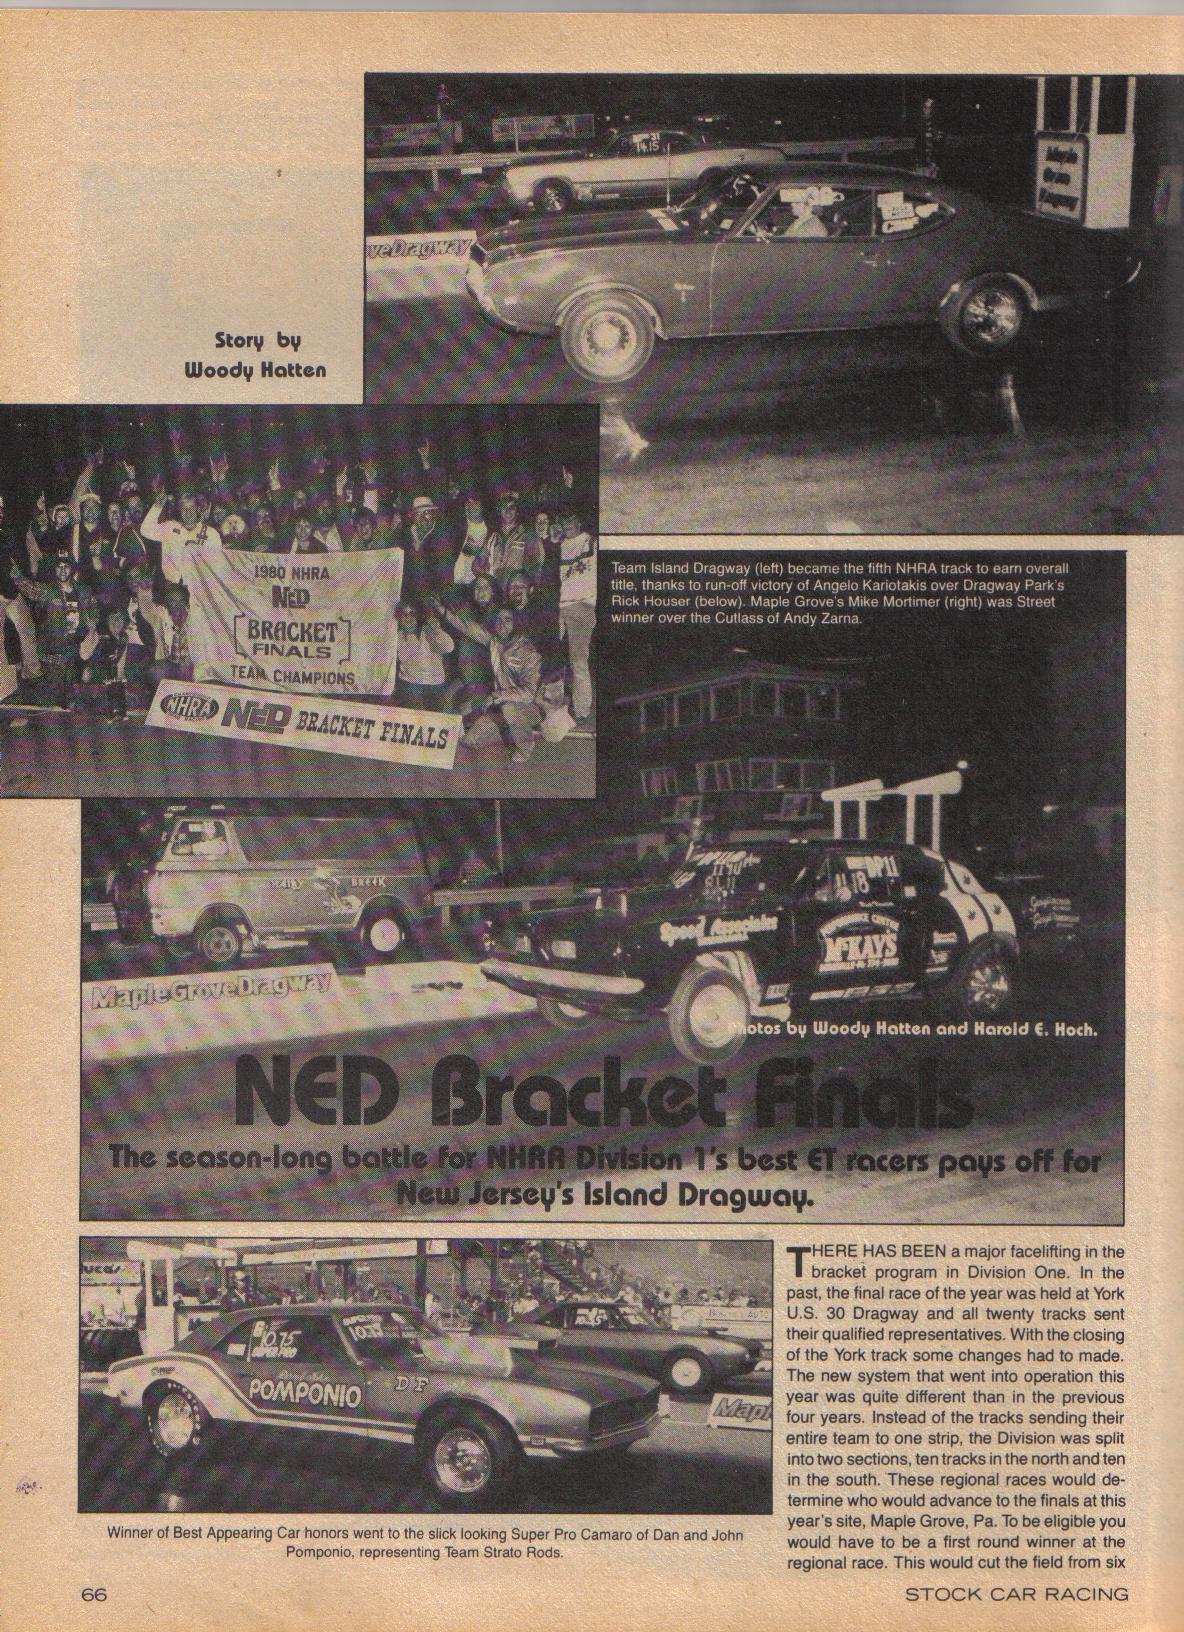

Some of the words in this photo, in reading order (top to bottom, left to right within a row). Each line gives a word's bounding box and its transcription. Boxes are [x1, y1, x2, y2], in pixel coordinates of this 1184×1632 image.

[216, 332, 263, 352] Story
[278, 332, 301, 352] by
[185, 362, 253, 382] Woody
[262, 362, 326, 377] Hatten
[253, 564, 285, 579] 1980
[292, 566, 330, 580] NHRA
[612, 562, 646, 573] Team
[652, 563, 688, 573] Island
[694, 562, 750, 576] Dragway
[756, 563, 783, 576] (left)
[789, 563, 839, 574] became
[844, 563, 863, 573] the
[869, 563, 891, 573] fifth
[897, 563, 936, 573] NHRA
[942, 564, 971, 573] track
[977, 564, 988, 574] to
[1026, 563, 1068, 573] overall
[612, 579, 637, 592] title,
[642, 580, 685, 590] thanks
[689, 580, 701, 590] to
[706, 580, 746, 590] run-off
[752, 580, 792, 593] victory
[798, 580, 809, 590] of
[814, 580, 858, 593] Angelo
[863, 580, 926, 590] Kariotakis
[931, 582, 958, 590] over
[964, 580, 1020, 593] Dragway
[1026, 580, 1064, 590] Park's
[612, 595, 639, 606] Rick
[645, 596, 690, 607] Houser
[695, 596, 747, 609] (below).
[751, 596, 789, 609] Maple
[795, 596, 843, 607] Grove's
[849, 596, 878, 607] Mike
[884, 596, 939, 607] Mortimer
[945, 597, 981, 610] (right)
[987, 599, 1012, 607] was
[1018, 596, 1055, 607] Street
[612, 614, 654, 623] winner
[659, 615, 686, 623] over
[691, 612, 710, 623] the
[716, 612, 763, 623] Cutlass
[767, 613, 779, 623] of
[784, 613, 816, 626] Andy
[822, 613, 861, 623] Zarna.
[247, 619, 339, 643] BRACKET
[252, 642, 332, 659] FINALS
[231, 664, 267, 680] TEAM
[273, 670, 355, 686] CHAMPIONS
[165, 694, 214, 718] NHRA
[220, 697, 292, 733] NED
[295, 710, 376, 739] BRACKET
[379, 721, 449, 750] FINALS
[787, 1021, 806, 1038] by
[814, 1021, 870, 1038] Woody
[877, 1022, 930, 1035] Hatten
[937, 1022, 968, 1035] and
[975, 1022, 1028, 1035] Harold
[1035, 1023, 1048, 1036] E.
[1056, 1023, 1097, 1036] Hoch.
[236, 1054, 400, 1127] NED
[432, 1054, 727, 1128] Bracket
[757, 1056, 974, 1130] Finals
[109, 1144, 158, 1169] The
[166, 1144, 333, 1175] season-long
[343, 1145, 428, 1170] battle
[439, 1145, 477, 1170] for
[488, 1146, 565, 1170] NHRA
[577, 1147, 682, 1171] Division
[698, 1147, 728, 1171] 1's
[738, 1148, 798, 1172] best
[808, 1148, 838, 1172] ET
[847, 1154, 929, 1173] racers
[939, 1154, 1006, 1178] pays
[1015, 1149, 1054, 1173] off
[1064, 1149, 1101, 1174] for
[399, 1181, 460, 1206] New
[469, 1181, 574, 1212] Jersey's
[584, 1182, 667, 1206] Island
[679, 1182, 815, 1213] Dragway.
[864, 1245, 896, 1257] HAS
[902, 1245, 945, 1257] BEEN
[952, 1248, 960, 1257] a
[965, 1248, 1006, 1260] major
[1011, 1245, 1080, 1261] facelifting
[1086, 1249, 1097, 1257] in
[1103, 1246, 1124, 1258] the
[248, 1379, 362, 1409] POMPONIO
[108, 1527, 153, 1538] Winner
[158, 1527, 169, 1538] of
[174, 1527, 201, 1538] Best
[207, 1527, 272, 1542] Appearing
[278, 1527, 300, 1538] Car
[305, 1528, 348, 1538] honors
[354, 1528, 383, 1538] went
[389, 1528, 399, 1539] to
[405, 1528, 423, 1539] the
[429, 1528, 456, 1539] slick
[462, 1528, 506, 1543] looking
[512, 1528, 549, 1543] Super
[555, 1529, 576, 1540] Pro
[582, 1529, 631, 1540] Camaro
[637, 1529, 648, 1540] of
[654, 1529, 678, 1540] Dan
[684, 1530, 707, 1540] and
[712, 1530, 743, 1541] John
[287, 1546, 354, 1560] Pomponio,
[360, 1548, 439, 1560] representing
[446, 1547, 478, 1557] Team
[484, 1547, 521, 1557] Strato
[527, 1547, 562, 1558] Rods.
[788, 1557, 846, 1572] regional
[853, 1559, 886, 1569] race.
[894, 1556, 924, 1569] This
[930, 1556, 972, 1568] would
[979, 1557, 1000, 1568] cut
[1005, 1556, 1027, 1568] the
[1033, 1556, 1062, 1568] field
[1069, 1556, 1100, 1568] from
[1107, 1559, 1125, 1568] six
[82, 1588, 107, 1601] 66
[906, 1588, 981, 1601] STOCK
[991, 1588, 1035, 1601] CAR
[1046, 1588, 1128, 1601] RACING
